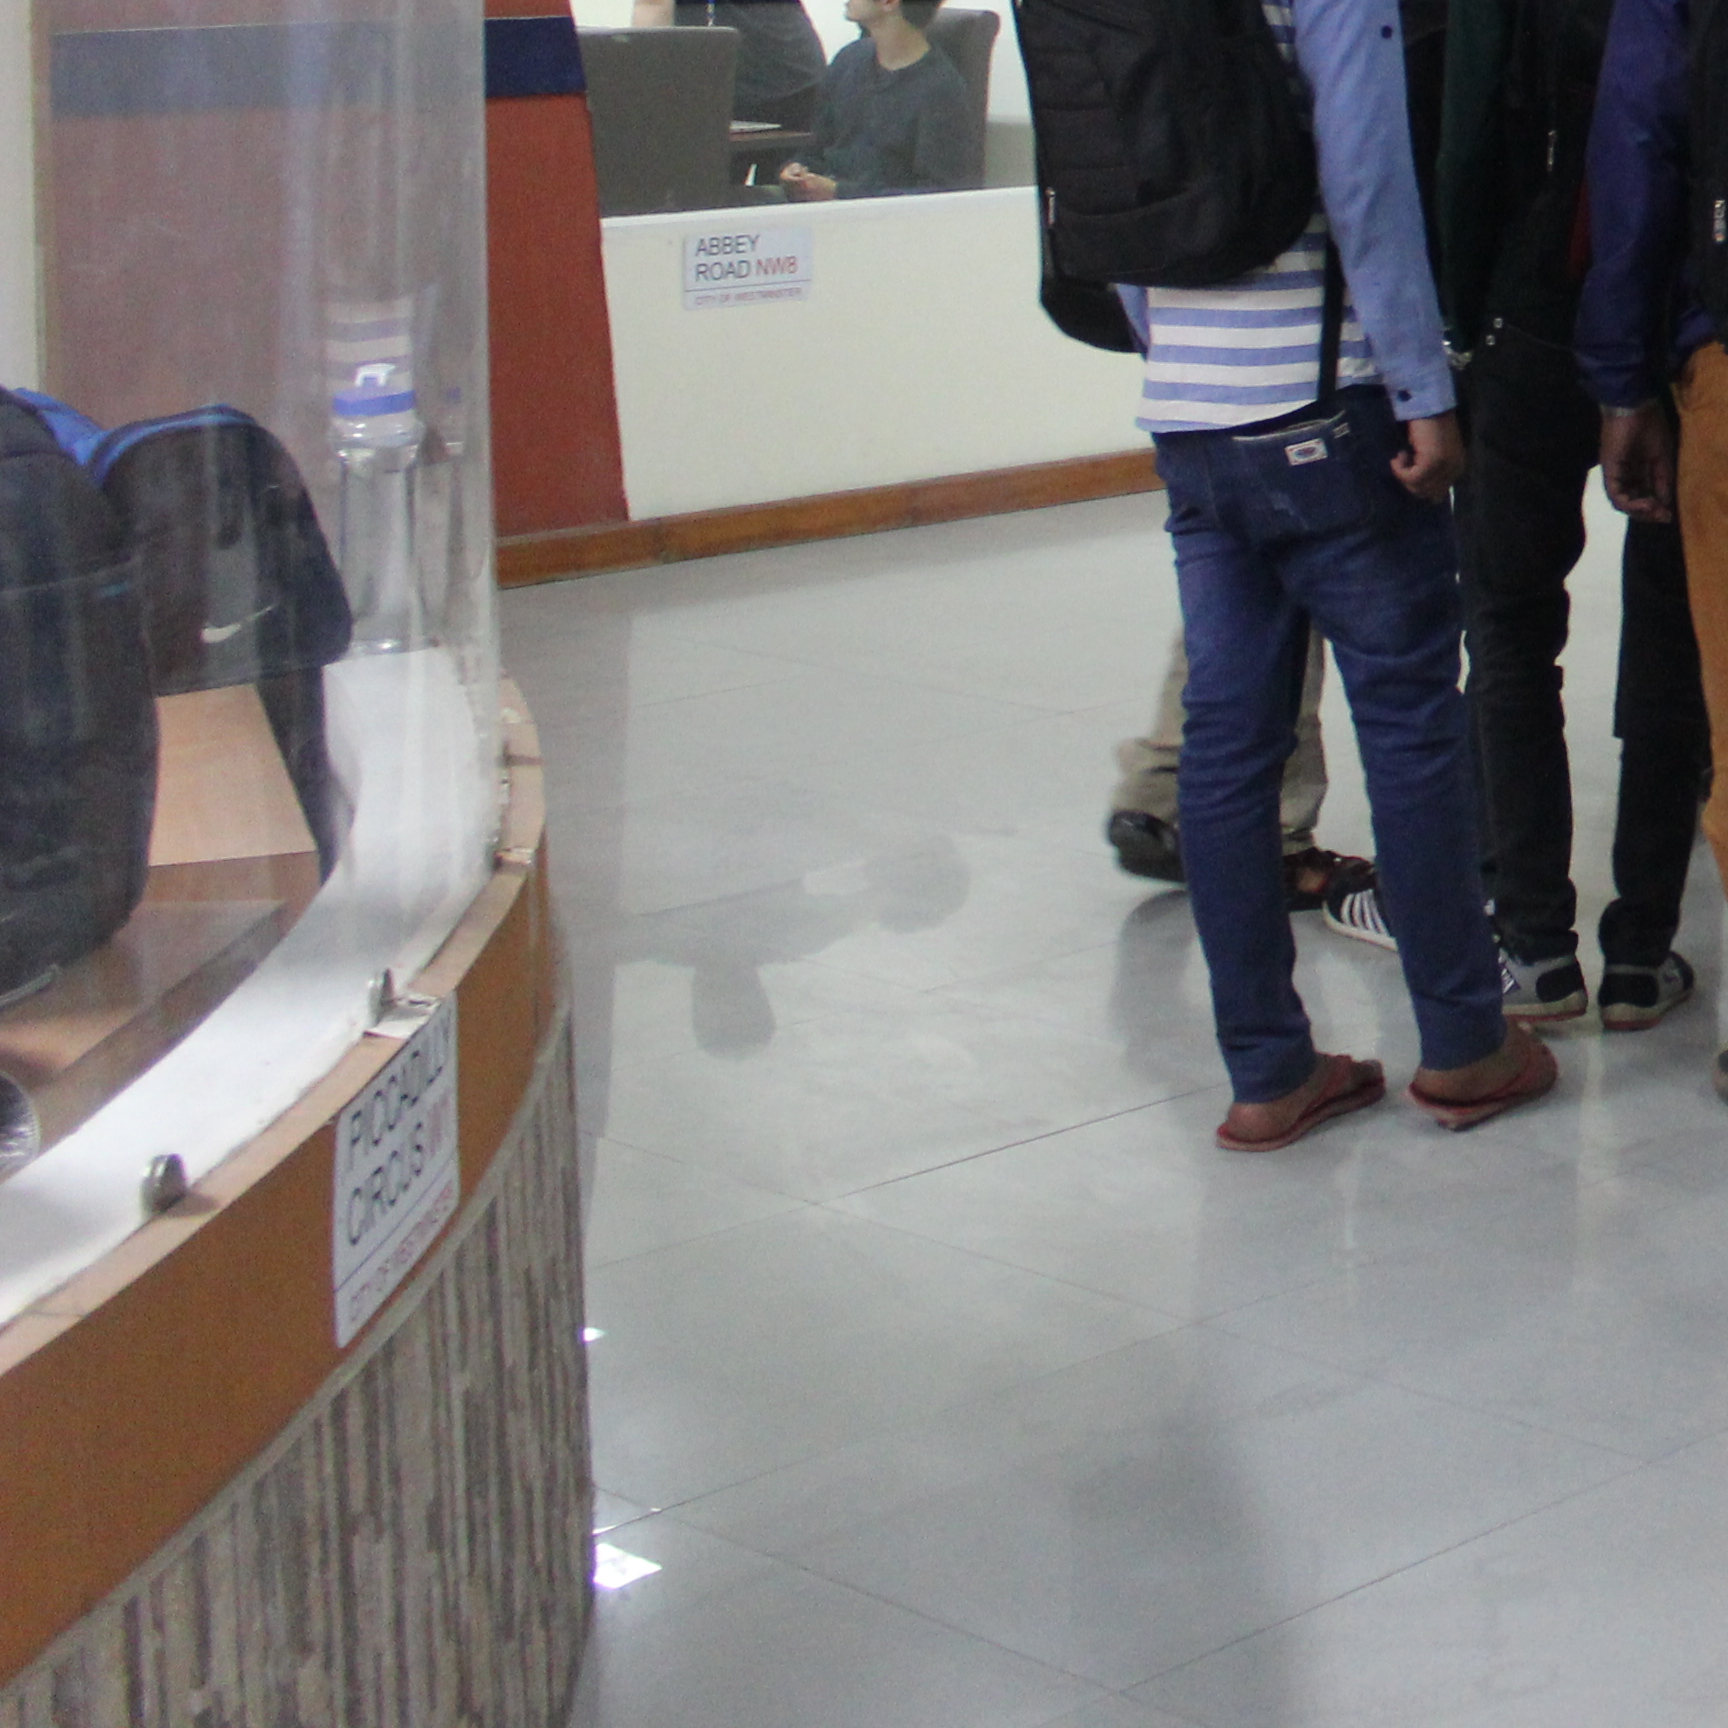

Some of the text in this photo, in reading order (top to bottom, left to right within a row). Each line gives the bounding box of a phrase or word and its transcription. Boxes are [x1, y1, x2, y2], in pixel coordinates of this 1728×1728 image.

[695, 234, 760, 256] ABBEY
[695, 255, 798, 282] ROAD NW8
[349, 1010, 451, 1170] PICCADILLY
[349, 1120, 423, 1246] CIRCUS
